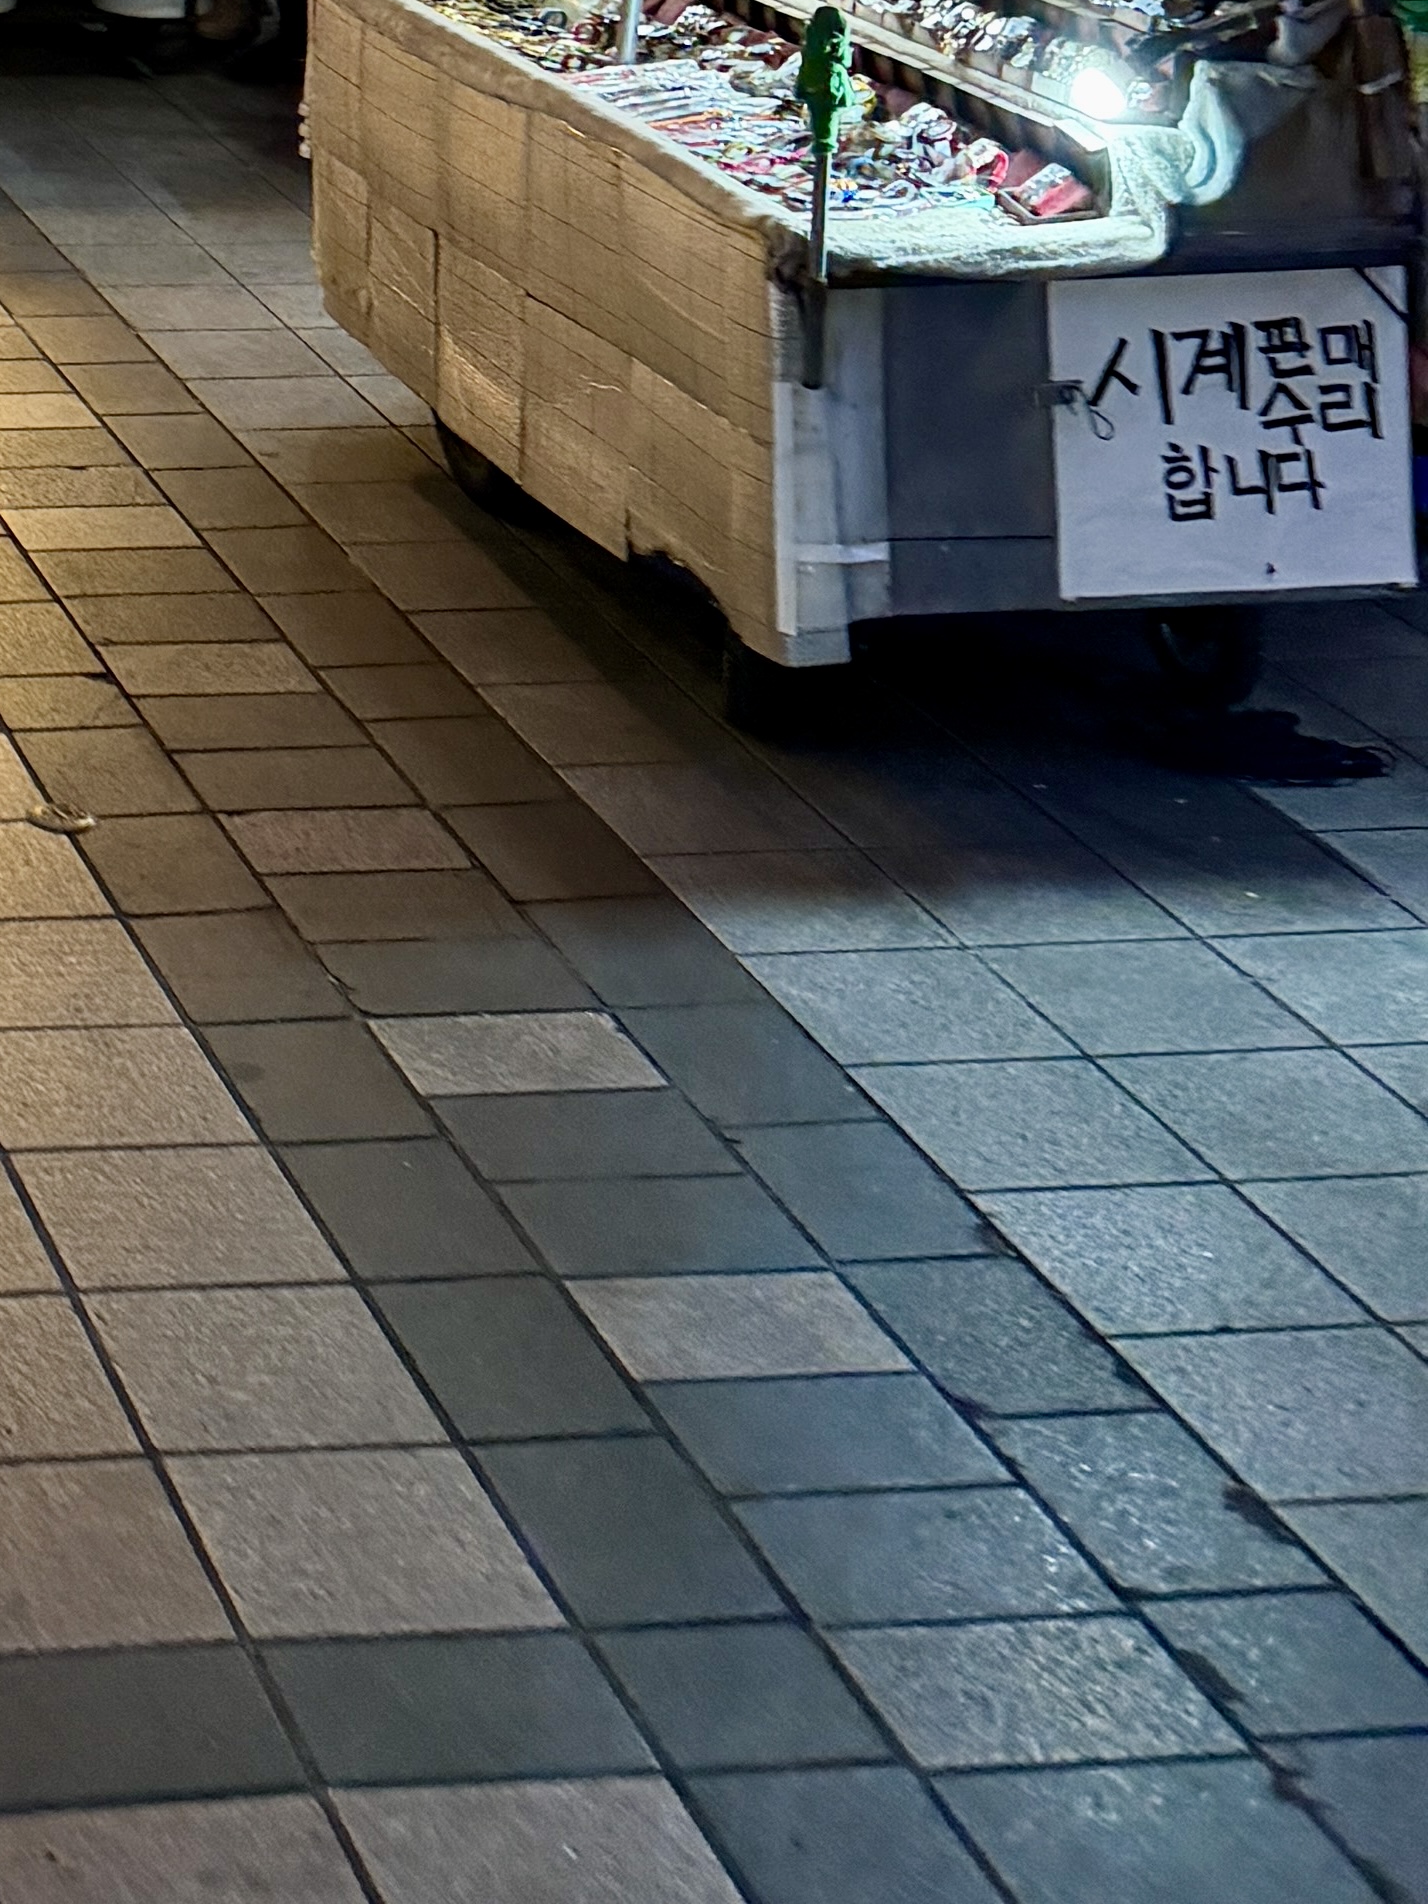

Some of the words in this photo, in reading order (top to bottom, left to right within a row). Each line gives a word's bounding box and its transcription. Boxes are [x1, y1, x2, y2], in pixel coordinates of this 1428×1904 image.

[1089, 319, 1250, 425] 시계
[1251, 316, 1380, 383] 판매
[1258, 380, 1384, 446] 수리
[1160, 442, 1327, 522] 합니다
